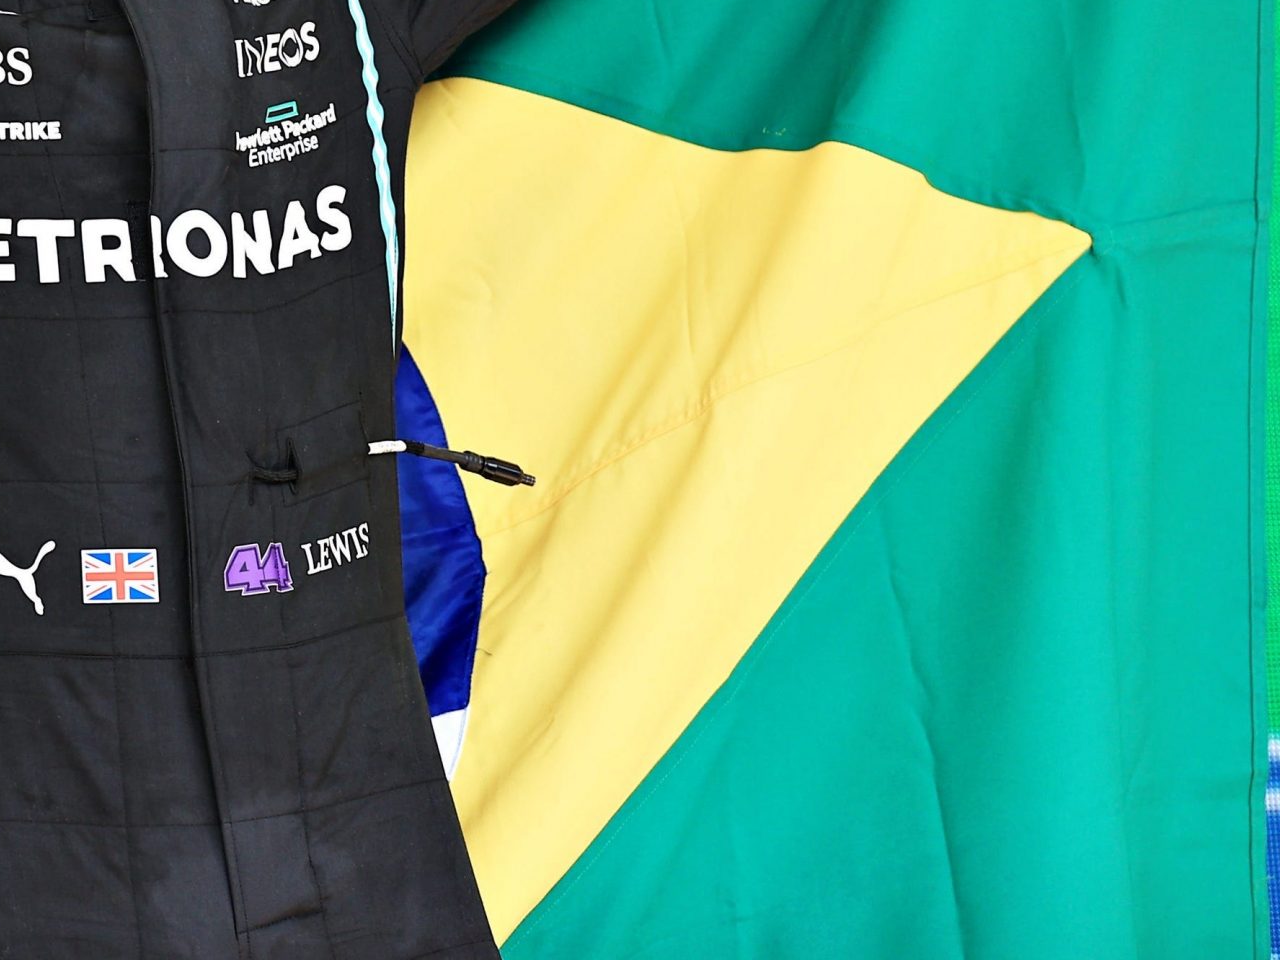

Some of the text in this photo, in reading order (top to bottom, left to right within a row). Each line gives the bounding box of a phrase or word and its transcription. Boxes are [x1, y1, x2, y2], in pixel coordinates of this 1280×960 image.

[234, 21, 320, 78] INEOS
[248, 135, 319, 168] Enterprise
[224, 522, 369, 596] 44 LEWIS
